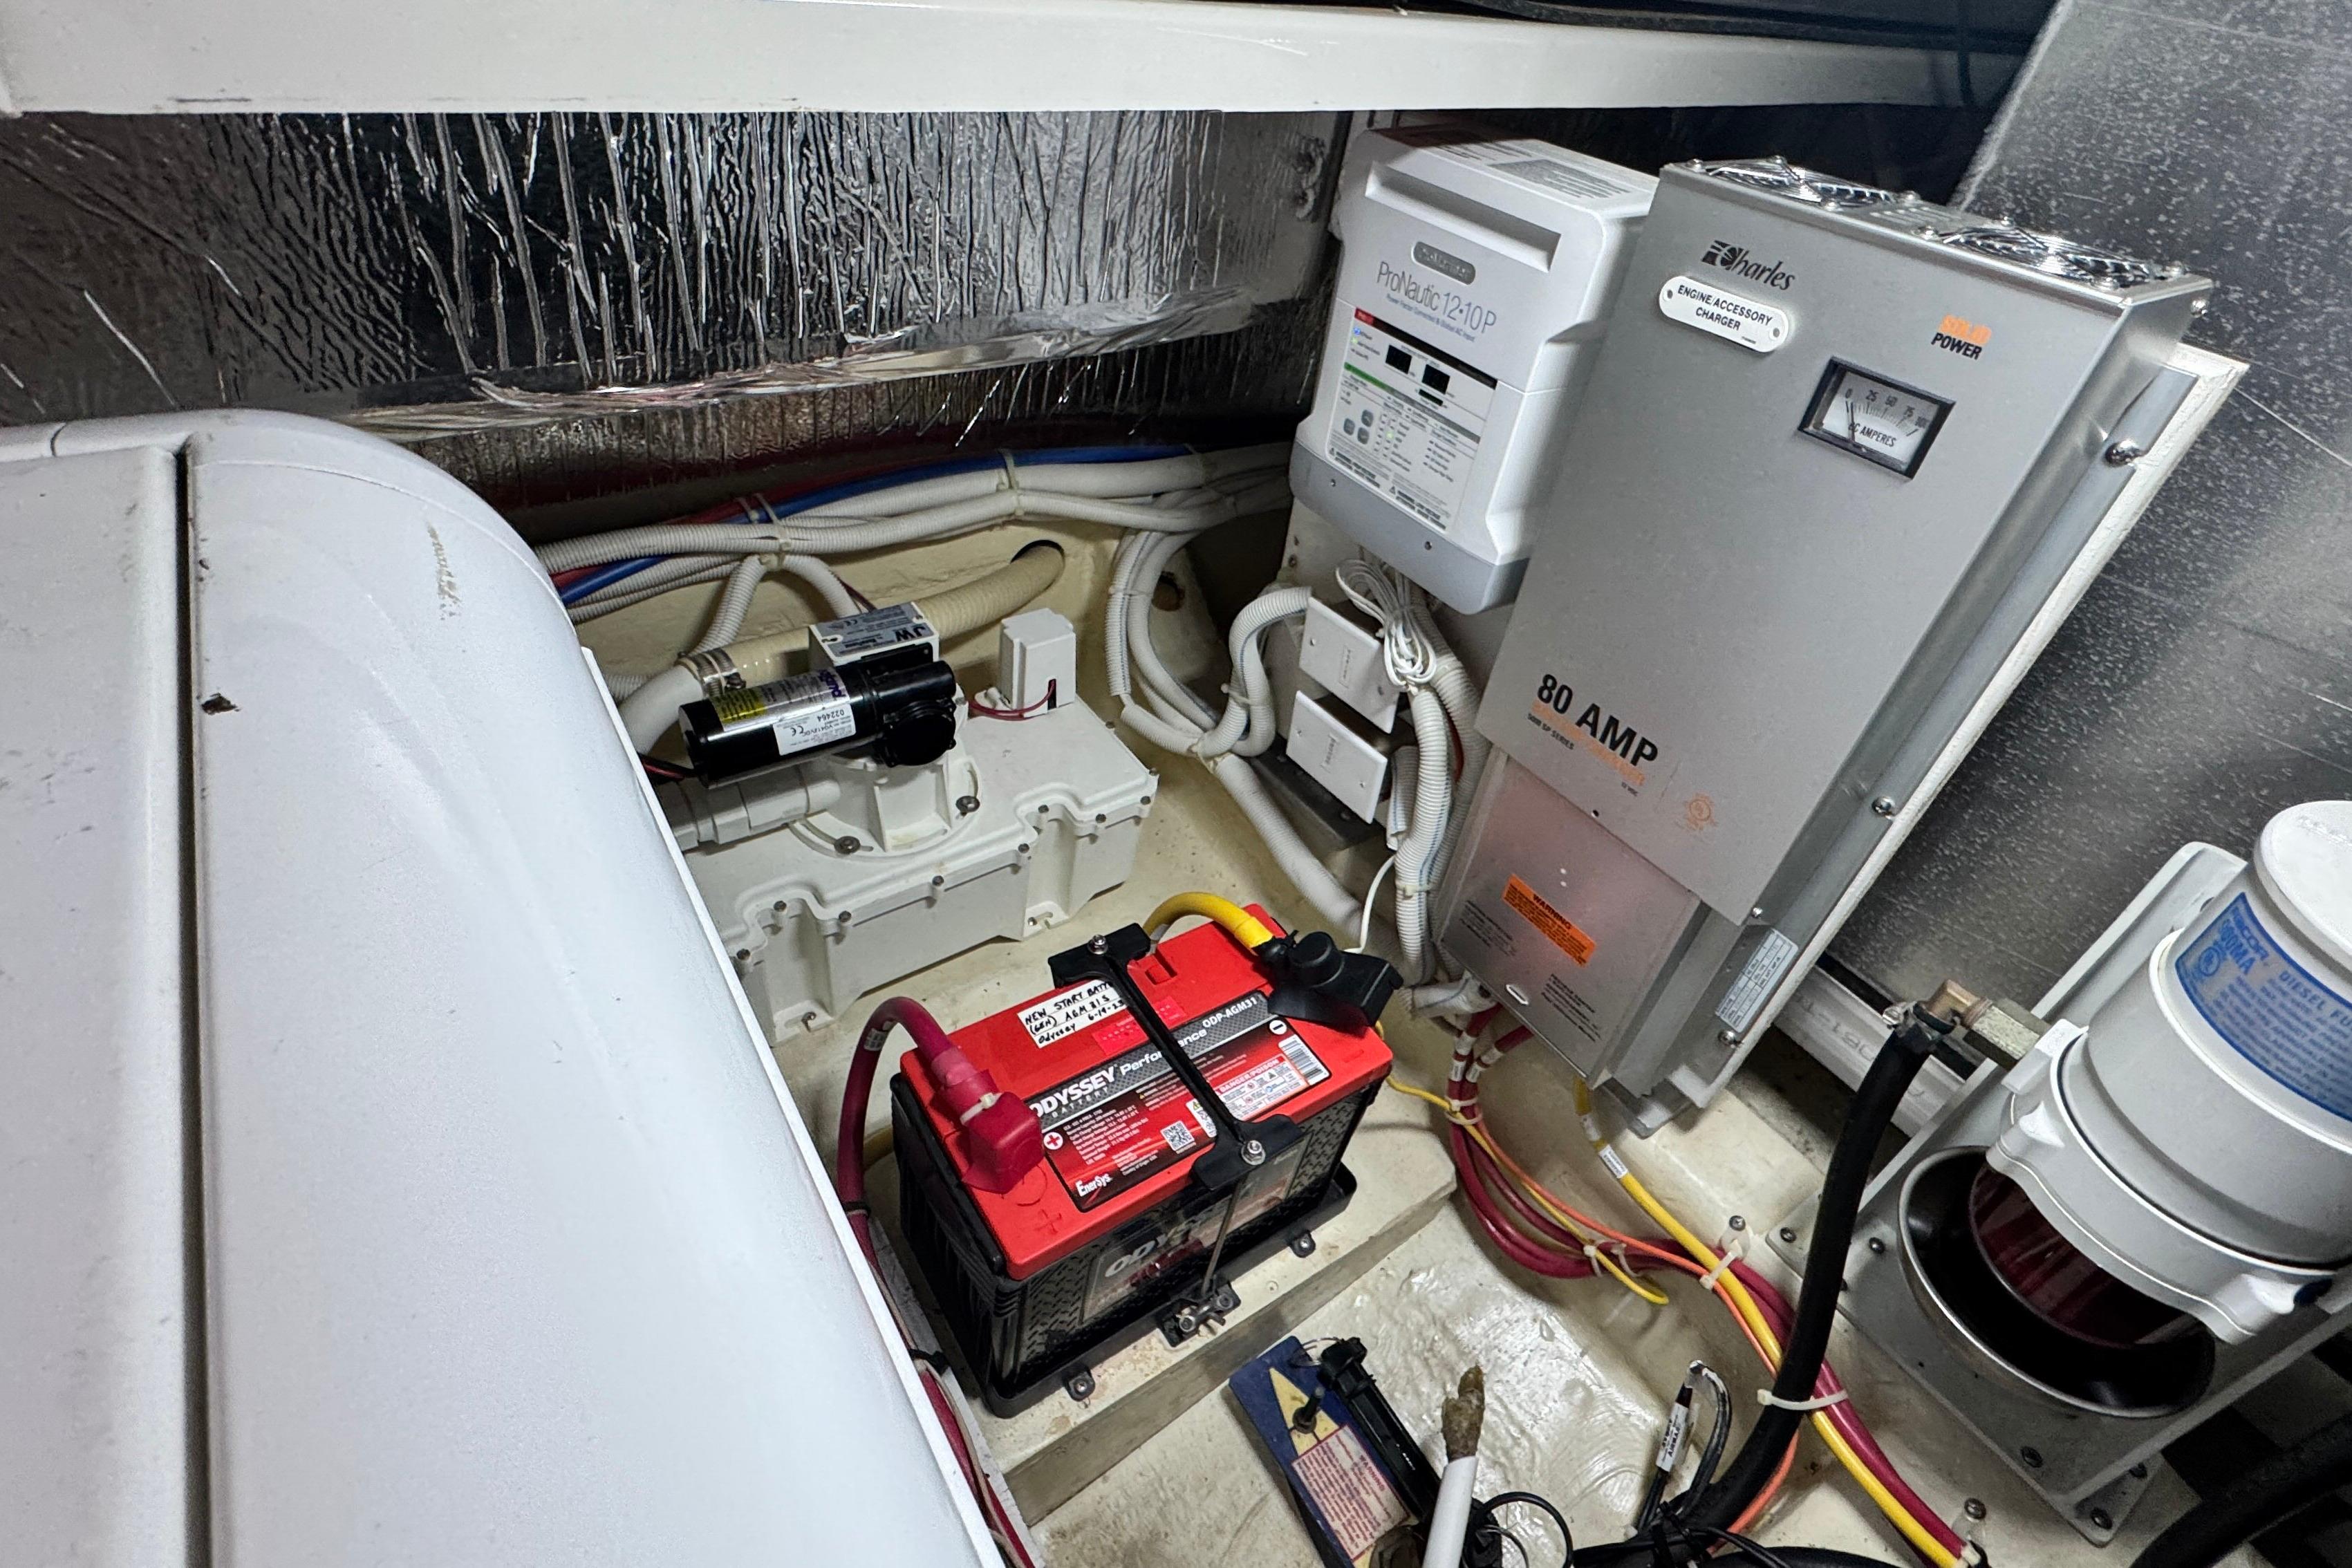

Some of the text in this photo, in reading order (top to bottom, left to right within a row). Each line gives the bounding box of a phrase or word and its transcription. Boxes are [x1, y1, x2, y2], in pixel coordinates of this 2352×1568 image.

[1376, 261, 1439, 310] ProNautic
[1677, 284, 1773, 326] ENGINE/ACCESSORY
[1695, 306, 1741, 331] CHARGER
[1931, 332, 1983, 360] POWER
[1865, 389, 1879, 402] 25
[1860, 425, 1897, 447] AMPERES
[1537, 673, 1574, 715] 80
[1575, 703, 1659, 767] AMP
[1532, 893, 1571, 930] WARNING
[2278, 970, 2326, 1011] DIESEL
[1025, 1009, 1046, 1025] NEW
[1054, 992, 1083, 1010] START
[1029, 1015, 1057, 1034] (GEN)
[1065, 1007, 1087, 1021] AGM
[1038, 1023, 1075, 1044] Odyssey
[1029, 1066, 1117, 1118] ODYSSEY
[1120, 1029, 1208, 1075] Perforance
[1202, 996, 1257, 1028] ODP-AGM31
[1219, 1058, 1280, 1092] DANGER/POISON
[1052, 1087, 1110, 1118] BATTERY
[1075, 1172, 1113, 1197] EnerSys
[1358, 1454, 1385, 1491] WARNING
